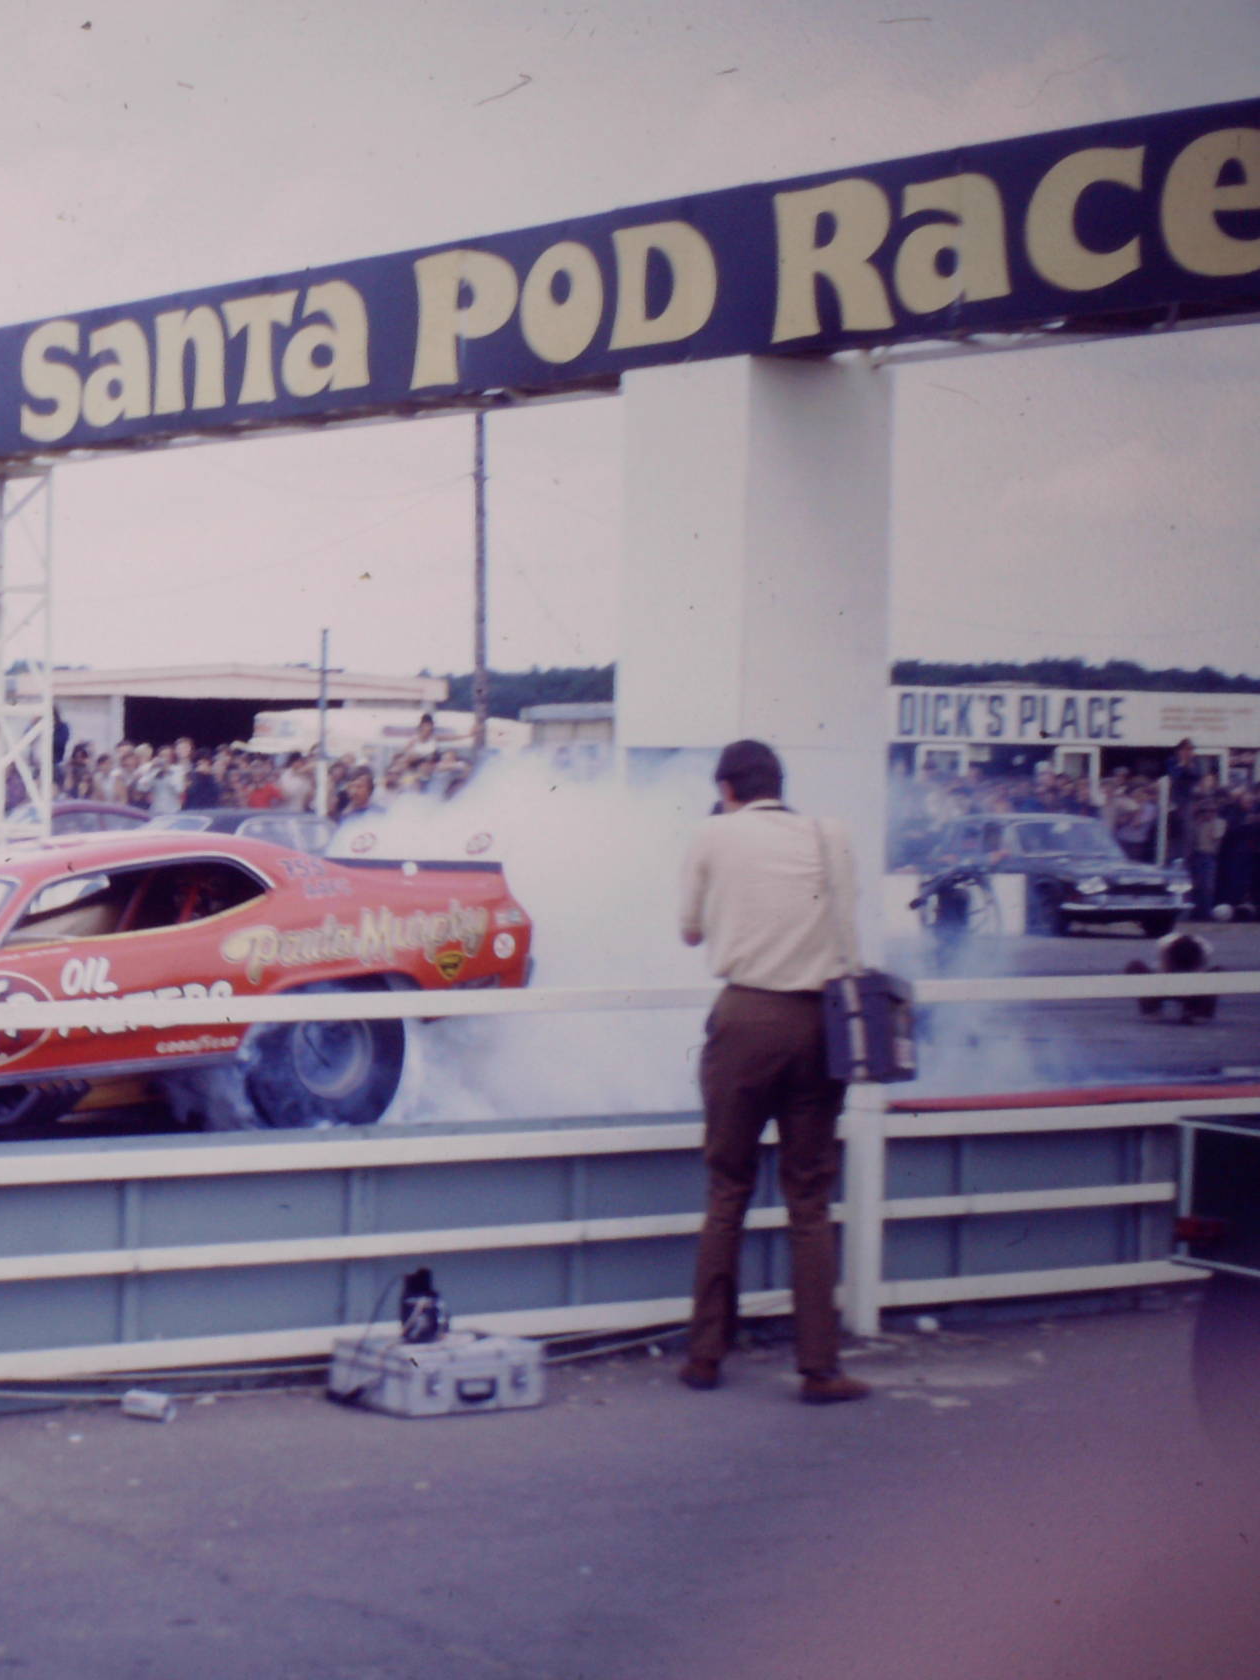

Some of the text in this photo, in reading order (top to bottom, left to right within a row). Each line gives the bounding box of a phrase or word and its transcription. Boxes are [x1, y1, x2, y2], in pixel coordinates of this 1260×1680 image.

[411, 220, 717, 390] POD
[897, 692, 1005, 737] DICK'S
[1017, 694, 1126, 739] PLACE
[61, 955, 119, 996] OIL
